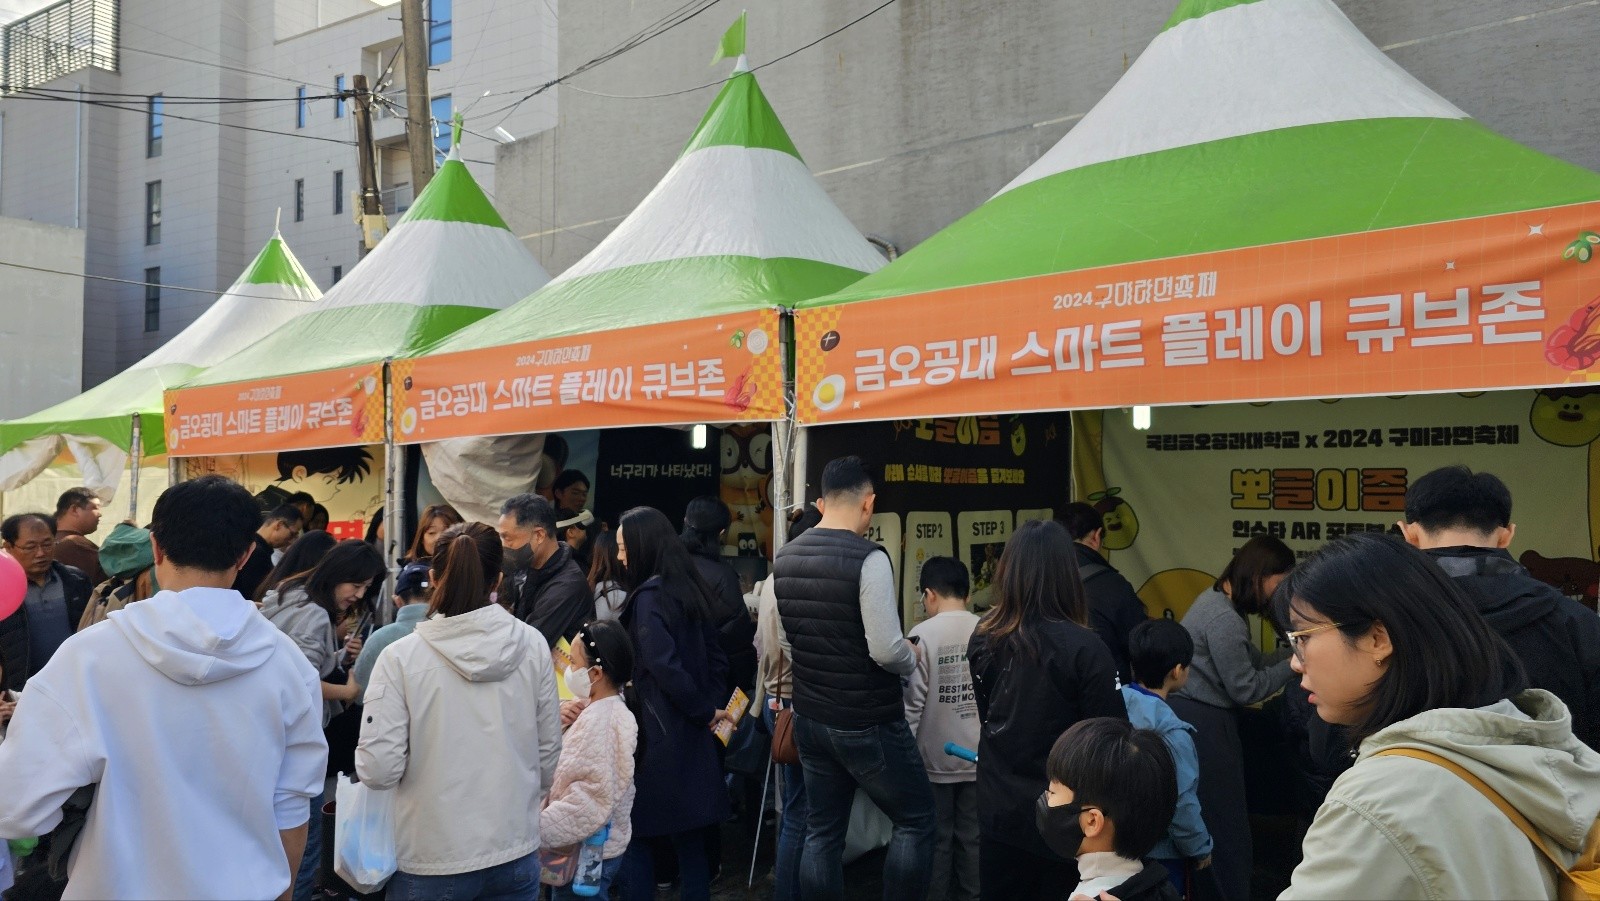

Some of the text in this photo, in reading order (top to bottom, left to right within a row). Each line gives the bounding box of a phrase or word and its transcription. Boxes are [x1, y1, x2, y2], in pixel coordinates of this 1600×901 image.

[1053, 271, 1217, 309] 2024 구미라면축제
[854, 280, 1546, 392] 금오공대 스마트 플레이 큐브존
[419, 358, 726, 421] 금오공대 스마트 플레이 큐브존
[180, 396, 353, 440] 금오공대 스마트 플레이 큐브존
[1146, 431, 1300, 451] 국립금오공과대학교
[1323, 428, 1384, 448] 2024
[1388, 424, 1520, 447] 구미라면축제
[610, 463, 712, 480] 너구리가 나타났다!
[916, 523, 943, 539] STEP 2
[972, 521, 1005, 536] STEP 3
[1232, 520, 1286, 540] 인스타
[1291, 521, 1321, 540] AR
[938, 655, 959, 665] BEST
[939, 685, 961, 693] BEST
[939, 694, 961, 704] BEST
